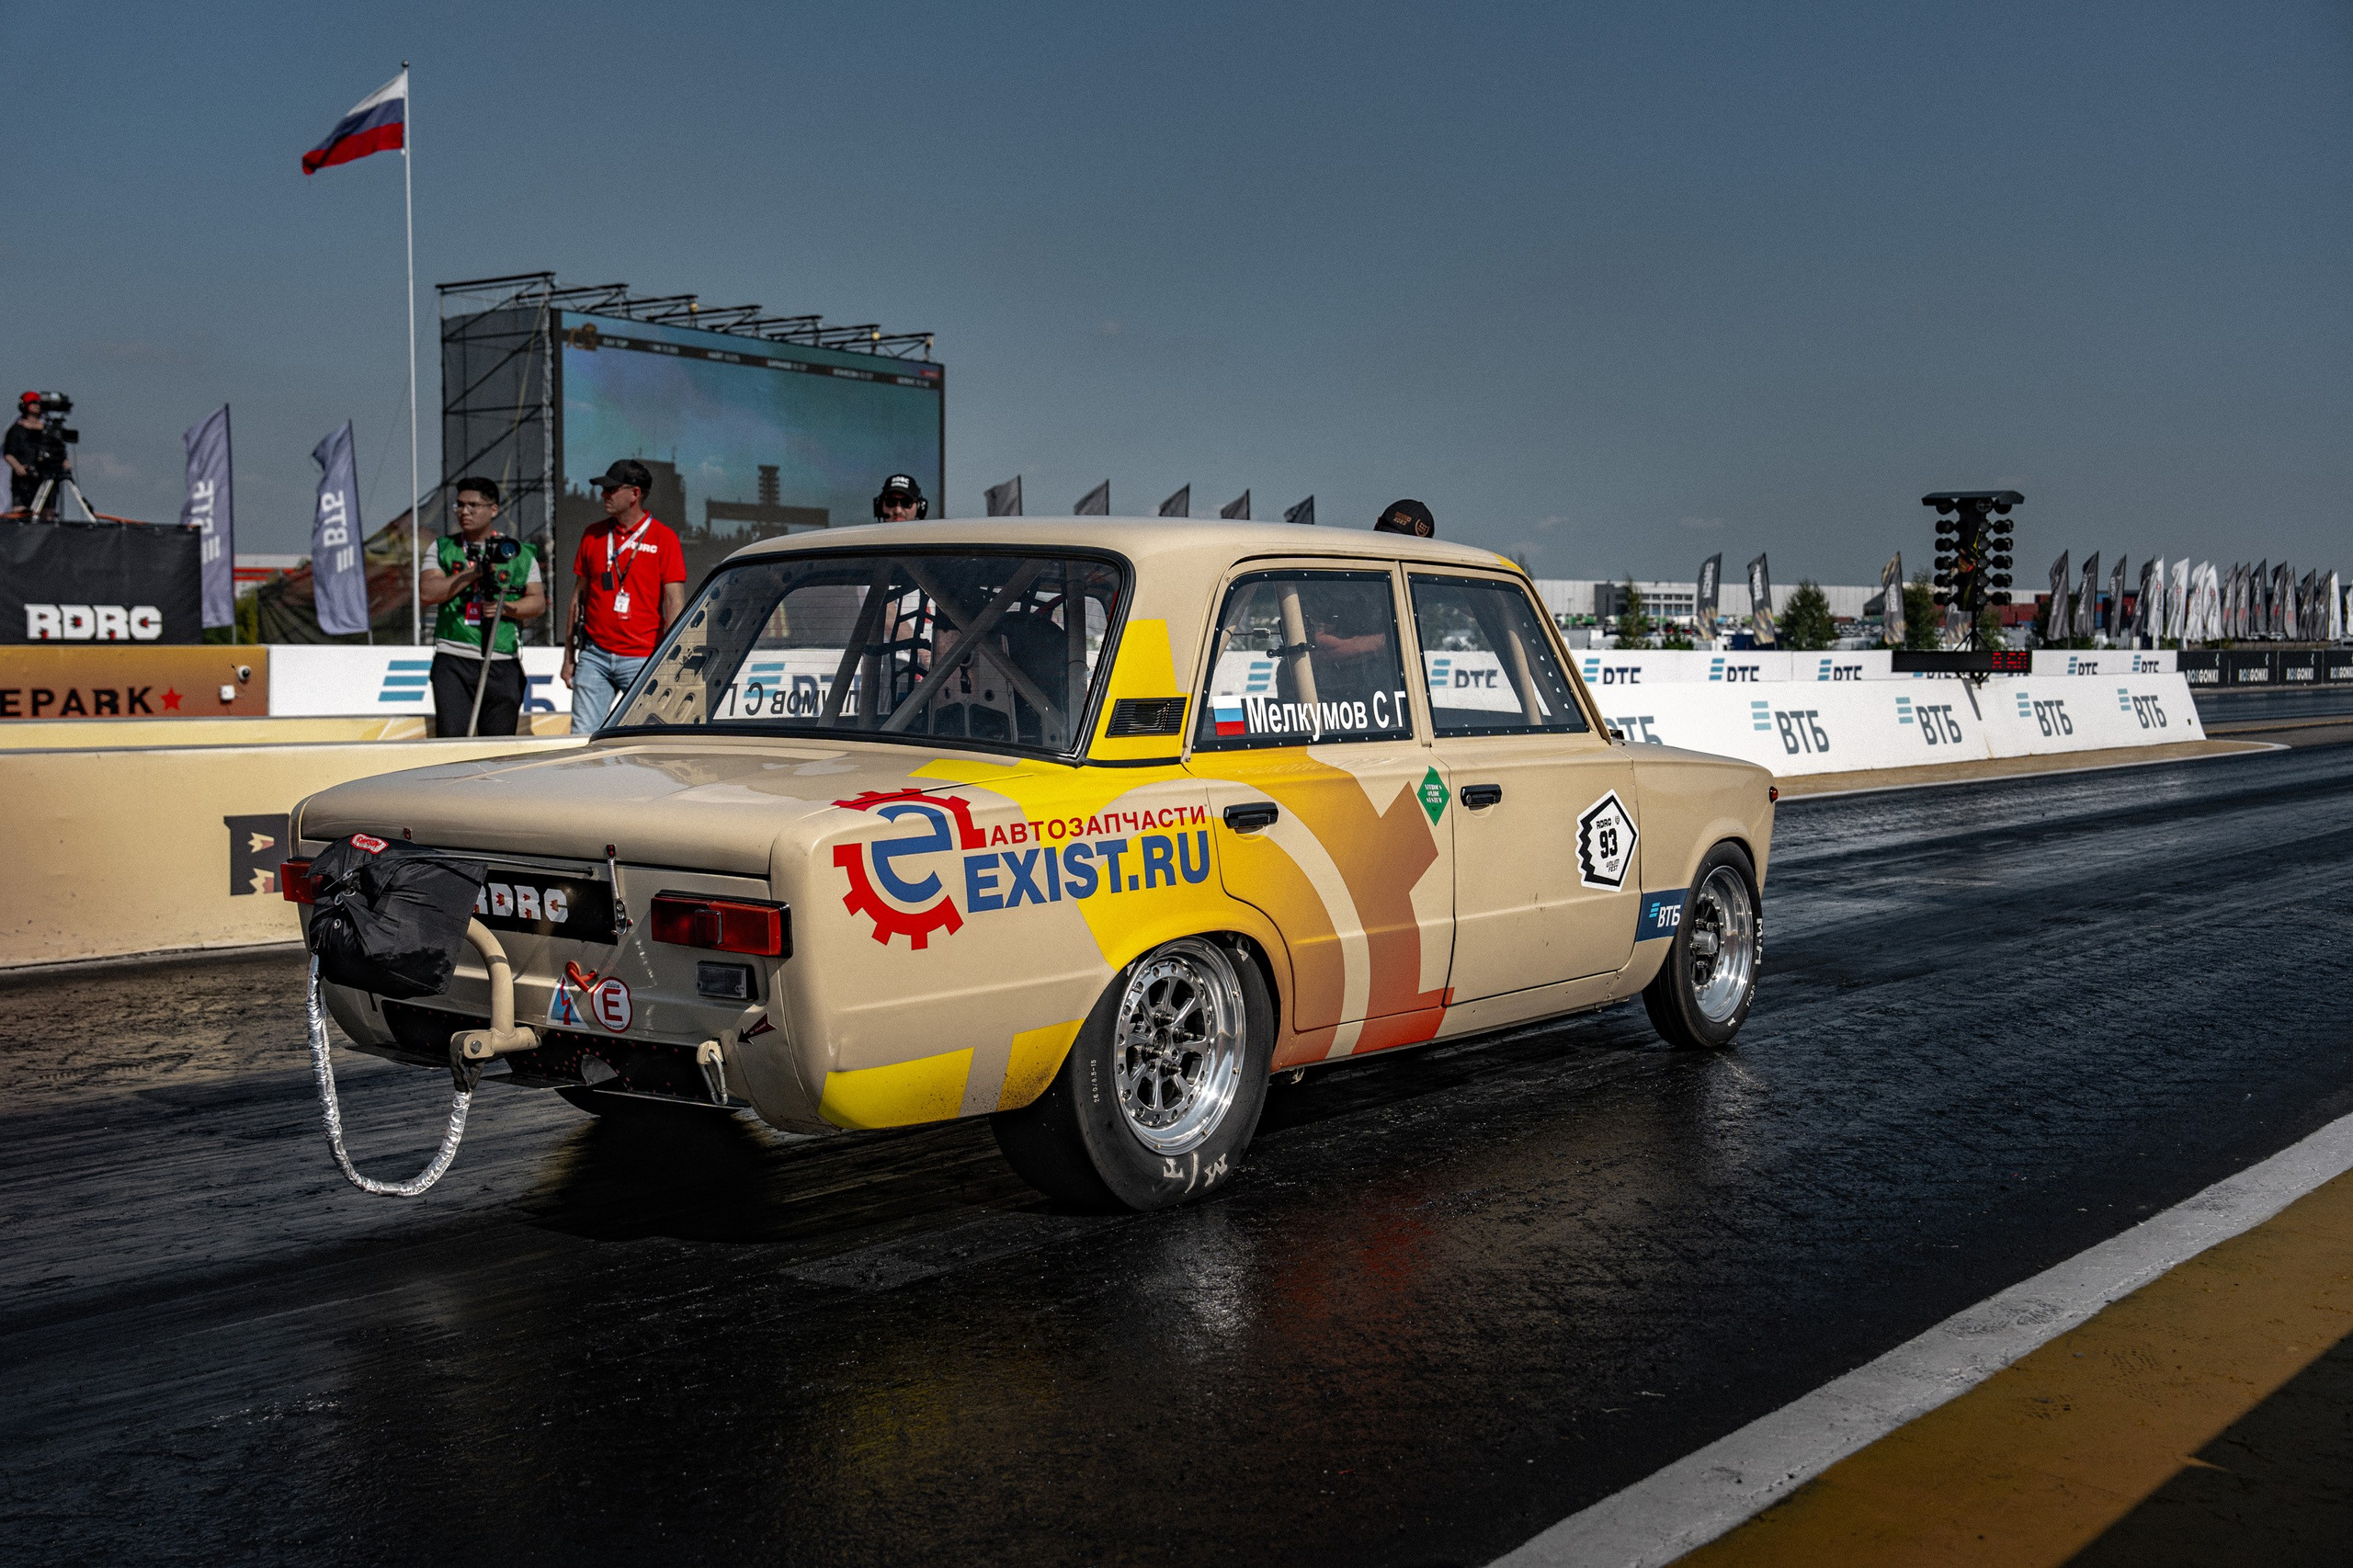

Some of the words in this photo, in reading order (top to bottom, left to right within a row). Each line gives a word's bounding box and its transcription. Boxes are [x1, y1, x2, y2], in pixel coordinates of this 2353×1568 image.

[24, 603, 163, 640] RDRC
[2187, 669, 2219, 683] ROSGONKI
[2239, 667, 2268, 682] ROSGONKI
[1245, 695, 1368, 741] Мелкумов
[1373, 689, 1387, 725] С
[1915, 704, 1962, 745] ВТБ
[2033, 699, 2073, 737] ВТБ
[2131, 695, 2167, 730] ВТБ
[1775, 710, 1830, 755] ВТБ
[991, 805, 1207, 846] АВТОЗАПЧАСТИ
[1599, 828, 1618, 858] 93
[963, 830, 1211, 914] EXIST.RU
[1657, 904, 1681, 928] ВТБ
[602, 987, 623, 1022] E
